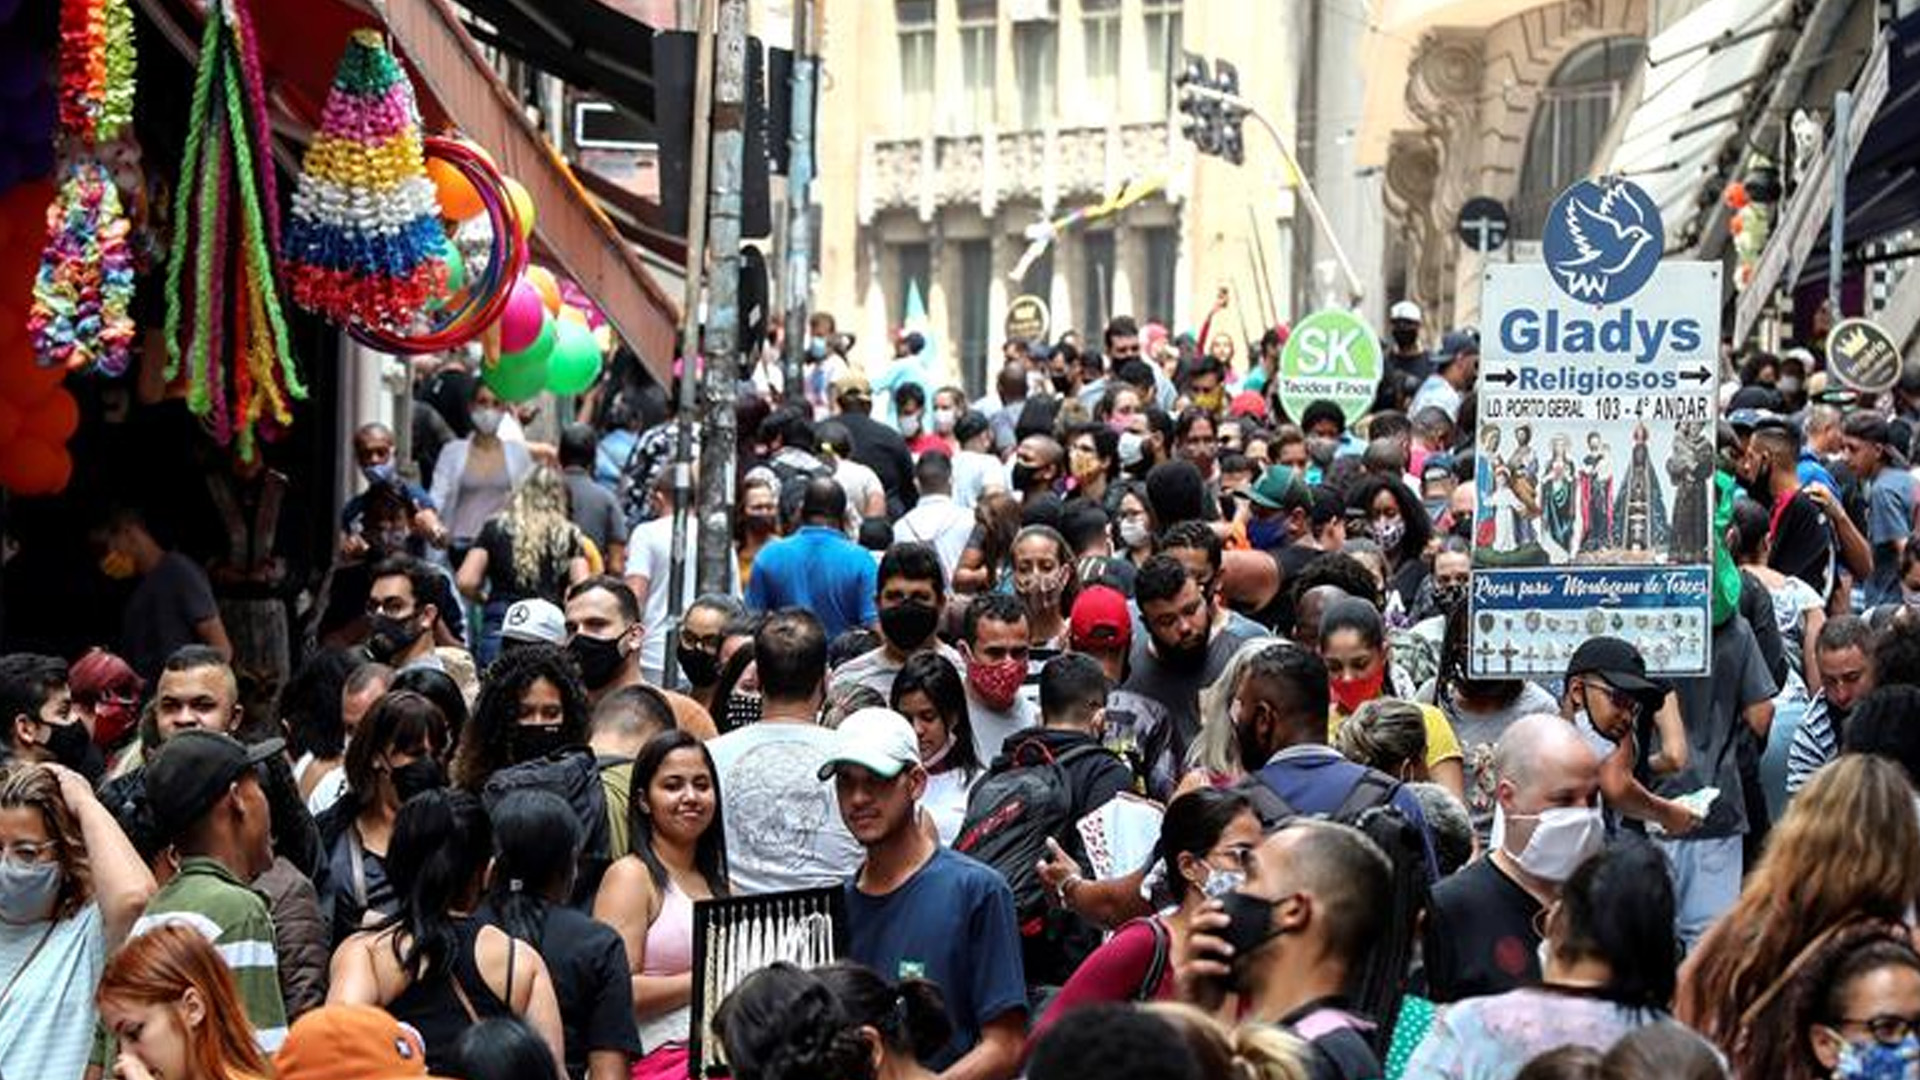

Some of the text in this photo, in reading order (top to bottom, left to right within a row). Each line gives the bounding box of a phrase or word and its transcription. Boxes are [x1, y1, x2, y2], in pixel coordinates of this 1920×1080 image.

[1297, 327, 1361, 374] SK
[1500, 308, 1701, 364] Gladys
[1283, 379, 1372, 396] Tecidos Finos
[1519, 366, 1677, 396] Religiosos
[1506, 398, 1546, 418] PORTO
[1548, 398, 1584, 418] GERAL
[1596, 397, 1620, 420] 103
[1652, 396, 1708, 420] ANDAR
[1518, 580, 1554, 602] para
[1643, 573, 1662, 595] de
